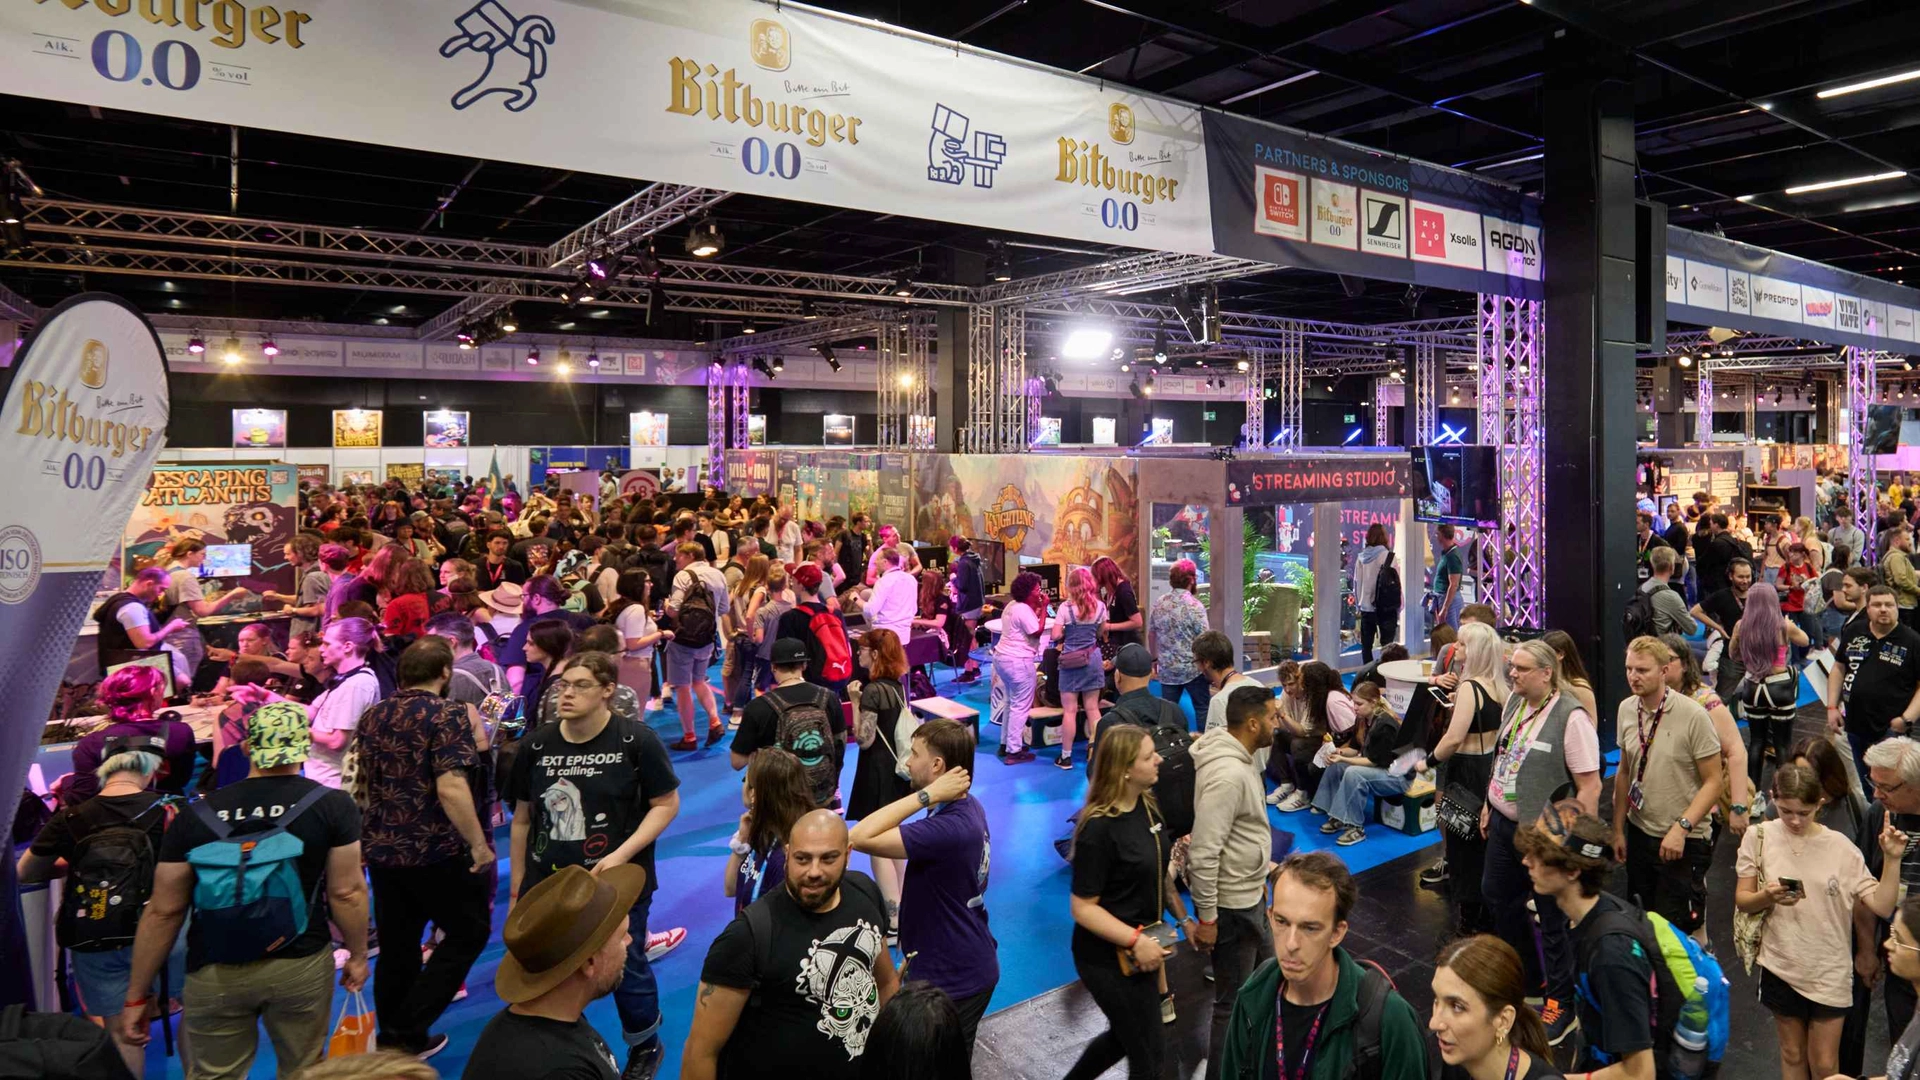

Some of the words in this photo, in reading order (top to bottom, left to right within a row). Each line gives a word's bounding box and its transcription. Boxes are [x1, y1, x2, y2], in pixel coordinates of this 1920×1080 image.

[44, 40, 74, 53] Alk.
[91, 29, 201, 91] 0.0
[784, 79, 809, 94] Bitte
[831, 80, 850, 93] Bit
[665, 56, 863, 147] Bitburger
[716, 147, 733, 155] Alk.
[741, 136, 801, 180] 0.0
[1255, 143, 1327, 175] PARTNERS
[1330, 162, 1340, 176] &
[1343, 166, 1409, 192] SPONSORS
[1055, 135, 1179, 205] Bitburger
[1101, 197, 1139, 231] 0.0
[1269, 209, 1294, 220] SWITCH
[1317, 205, 1353, 227] Bitburger
[1367, 238, 1401, 249] SENNHEISER
[1450, 233, 1477, 247] Xsolla
[1490, 230, 1536, 256] AGON
[1667, 271, 1679, 290] ity
[1764, 293, 1798, 306] PREDATOR
[16, 379, 152, 458] Bitburger
[63, 452, 105, 491] 0.0
[152, 469, 267, 488] ESCAPING
[1254, 472, 1342, 491] STREAMING
[1346, 470, 1395, 487] STUDIO
[142, 485, 272, 506] ATLANTIS
[983, 509, 1035, 540] KNIGHTLING
[0, 549, 30, 570] ISO
[566, 752, 623, 765] EPISODE
[546, 767, 555, 776] is
[558, 766, 603, 777] calling...
[217, 804, 297, 822] BLAD
